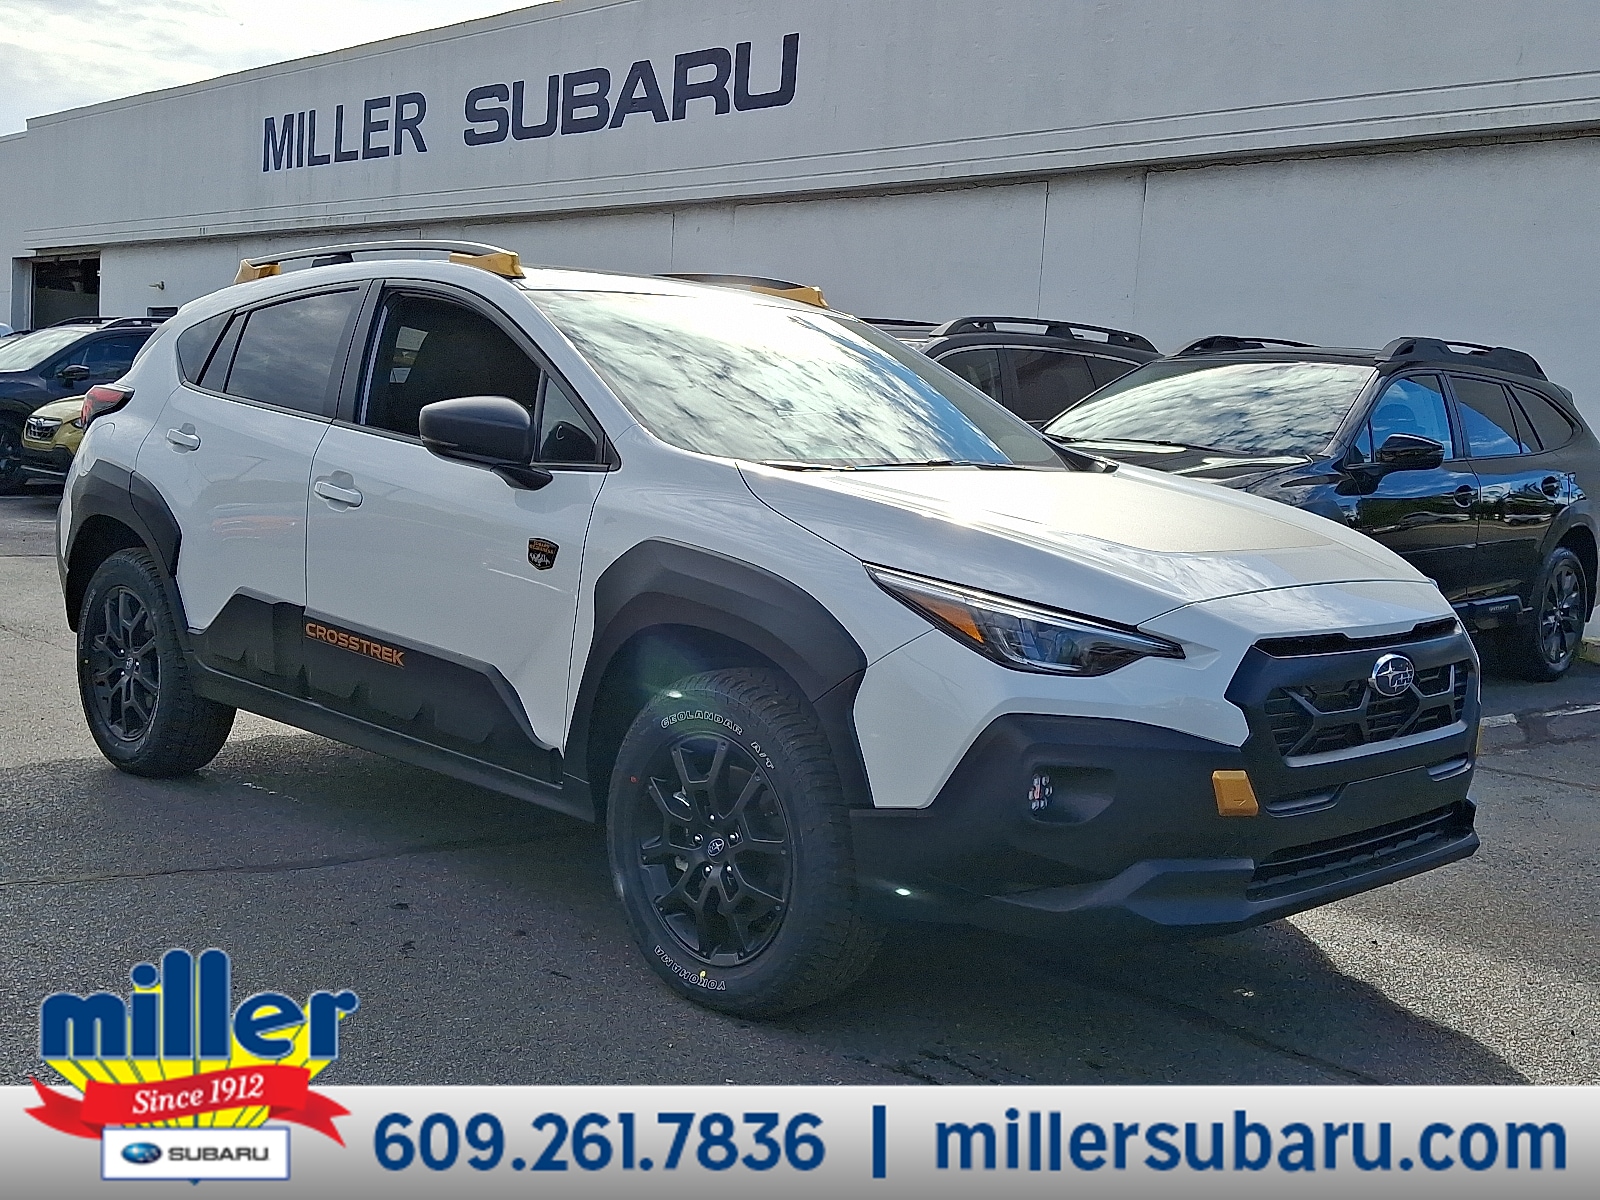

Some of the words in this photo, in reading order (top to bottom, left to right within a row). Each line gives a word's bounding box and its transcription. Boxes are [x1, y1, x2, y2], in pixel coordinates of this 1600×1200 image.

[262, 92, 428, 172] MILLER
[463, 32, 800, 147] SUBARU
[305, 622, 405, 667] CROSSTREK
[660, 710, 743, 736] GEOLANDAR
[654, 944, 727, 991] YOKOHAMA
